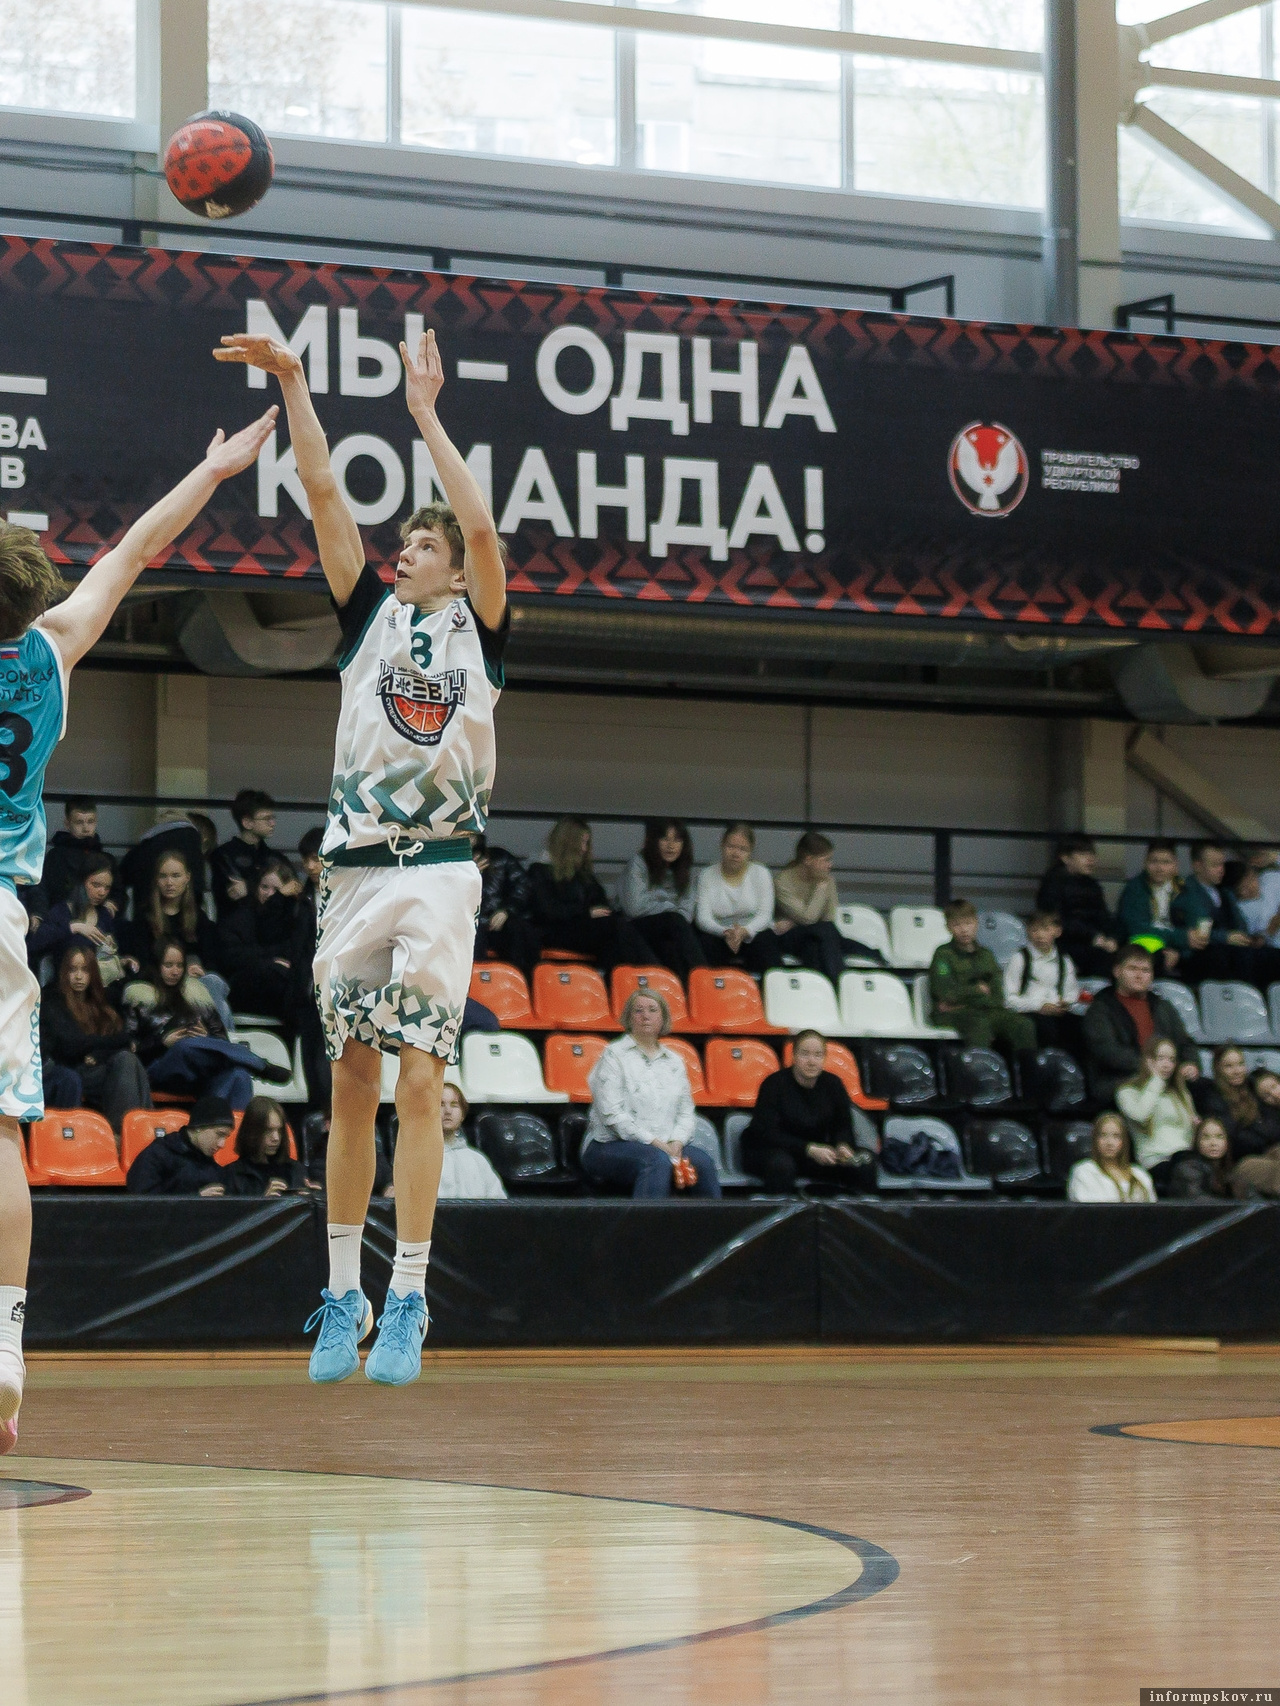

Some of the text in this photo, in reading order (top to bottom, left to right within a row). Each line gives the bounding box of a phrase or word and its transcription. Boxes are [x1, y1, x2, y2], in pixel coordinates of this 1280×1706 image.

[246, 299, 426, 397] МЫ
[536, 325, 837, 436] ОДНА
[1042, 451, 1140, 469] ПРАВИТЕЛЬСТВО
[1043, 464, 1120, 480] УДМУРТСКОЙ
[1042, 478, 1120, 494] РЕСПУБЛИКИ
[257, 430, 826, 561] КОМАНДА!
